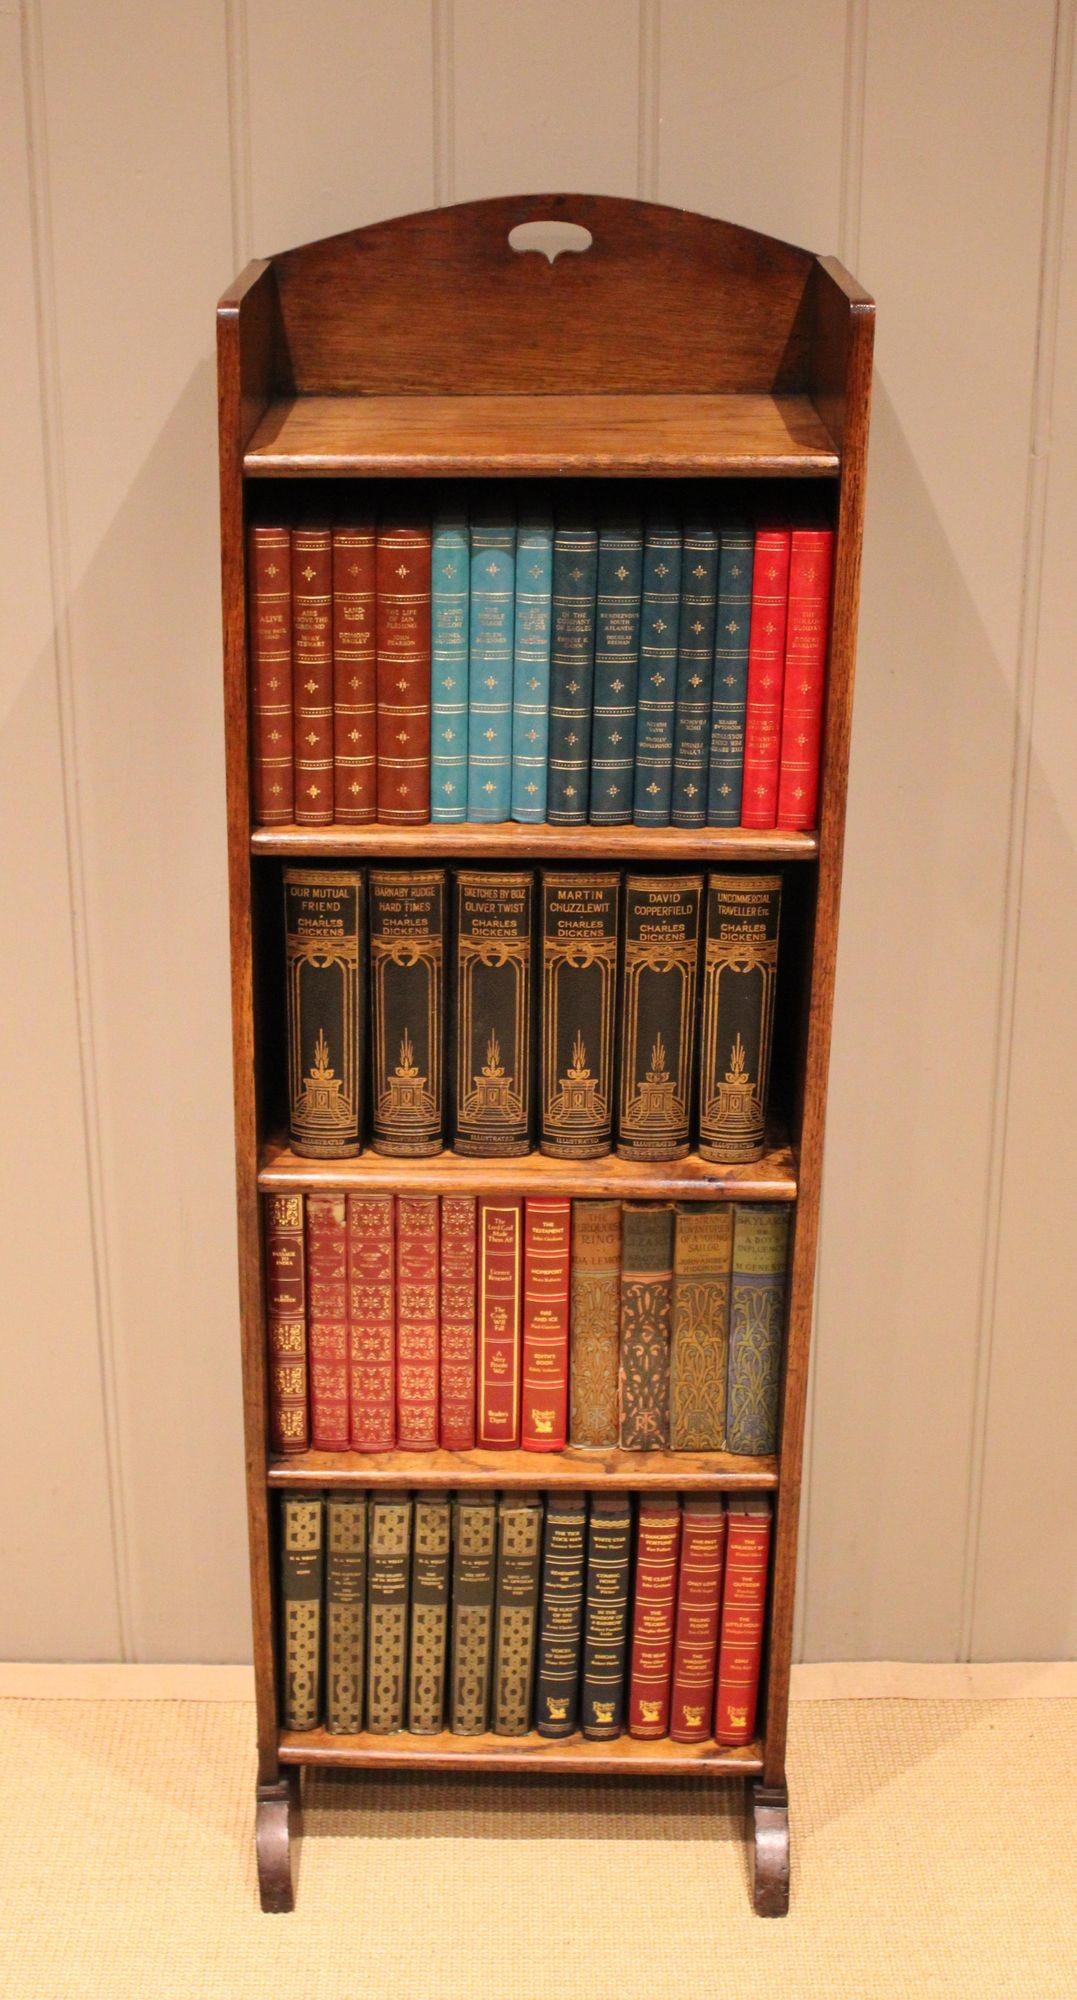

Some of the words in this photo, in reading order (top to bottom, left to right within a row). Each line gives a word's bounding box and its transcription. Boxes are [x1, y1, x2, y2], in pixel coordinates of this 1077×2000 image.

[290, 888, 310, 896] OUR
[312, 889, 350, 898] MUTUAL
[374, 888, 408, 896] BARNABY
[411, 887, 436, 896] RUDGE
[464, 888, 498, 898] SKETCHES
[500, 889, 510, 898] BY
[510, 889, 526, 898] BOZ
[558, 890, 603, 900] MARTIN
[650, 894, 680, 903] DAVID
[718, 892, 771, 904] UNCOMMERCIAL
[302, 902, 340, 912] FRIEND
[379, 902, 400, 912] HARD
[404, 902, 431, 912] TIMES
[465, 901, 496, 912] OLIVER
[499, 902, 524, 912] TWIST
[550, 902, 610, 913] CHUZZLEWIT
[634, 904, 693, 916] COPPERFIELD
[718, 905, 756, 916] TRAVELLER
[298, 918, 344, 928] CHARLES
[382, 918, 428, 926] CHARLES
[472, 919, 518, 928] CHARLES
[558, 920, 604, 928] CHARLES
[298, 928, 344, 936] DICKENS
[382, 928, 429, 936] DICKENS
[472, 928, 518, 936] DICKENS
[640, 924, 686, 932] CHARLES
[720, 924, 766, 932] CHARLES
[558, 928, 604, 938] DICKENS
[640, 933, 686, 941] DICKENS
[720, 933, 766, 941] DICKENS
[582, 1234, 614, 1244] RING
[688, 1244, 720, 1253] SAILOR
